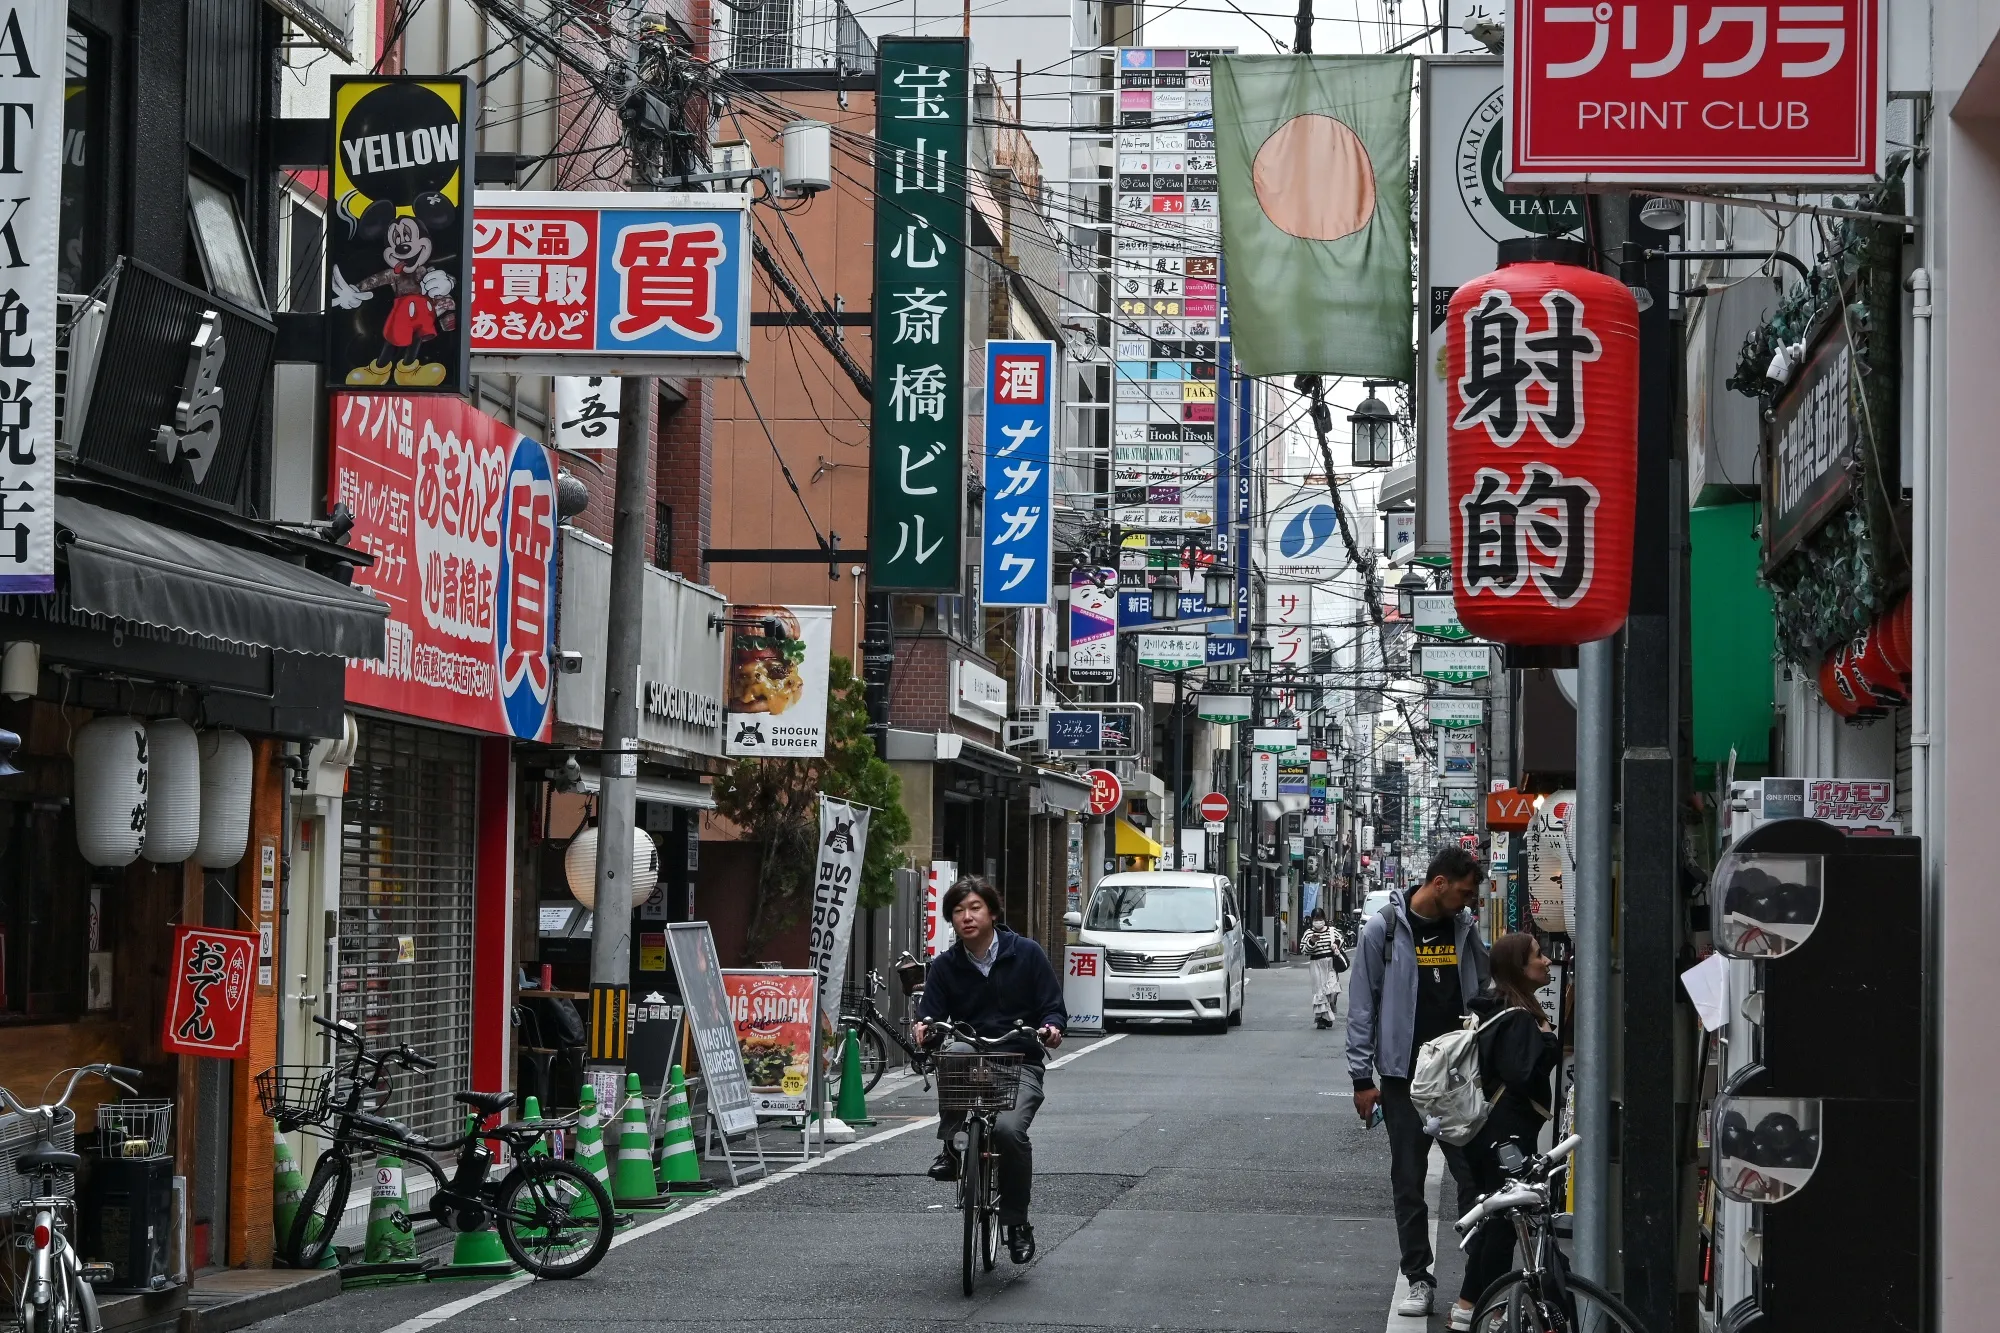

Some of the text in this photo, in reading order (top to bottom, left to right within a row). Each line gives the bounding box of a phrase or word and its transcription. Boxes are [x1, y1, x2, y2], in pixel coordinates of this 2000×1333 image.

[1544, 4, 1846, 79] プリクラ
[1578, 101, 1810, 130] PRINT CLUB
[343, 124, 459, 176] YELLOW
[1465, 128, 1486, 191] HALAL
[1163, 200, 1182, 211] まり
[1191, 263, 1215, 274] 三平
[613, 225, 724, 341] 質
[470, 310, 589, 340] あきんど
[889, 66, 948, 566] 宝山心斎橋ビル
[999, 358, 1040, 402] 酒
[1185, 387, 1214, 398] TAKA
[1150, 431, 1178, 441] Hook
[1457, 292, 1598, 604] 射的
[418, 426, 503, 549] あきんど
[425, 551, 492, 630] 心斎橋店
[504, 474, 552, 702] 質
[1119, 574, 1140, 585] ink
[1207, 642, 1235, 656] 寺ビル
[1458, 650, 1486, 659] COURT
[650, 680, 721, 729] SHOGUN BURGER
[771, 738, 818, 748] BURGER
[772, 726, 819, 736] SHOGUN
[1784, 794, 1802, 802] PIECE
[1810, 781, 1890, 803] ポケモン
[1496, 799, 1532, 817] YA
[1812, 803, 1885, 820] カードゲーム
[820, 862, 852, 996] SHOGUN
[1069, 951, 1098, 977] 酒
[1417, 956, 1453, 964] BASKETBALL
[178, 939, 227, 1041] おでん
[227, 957, 244, 1000] 味自慢
[738, 1014, 794, 1032] California
[753, 997, 810, 1024] SHOCK
[700, 1025, 731, 1051] WAGYU
[706, 1049, 738, 1075] BURGER
